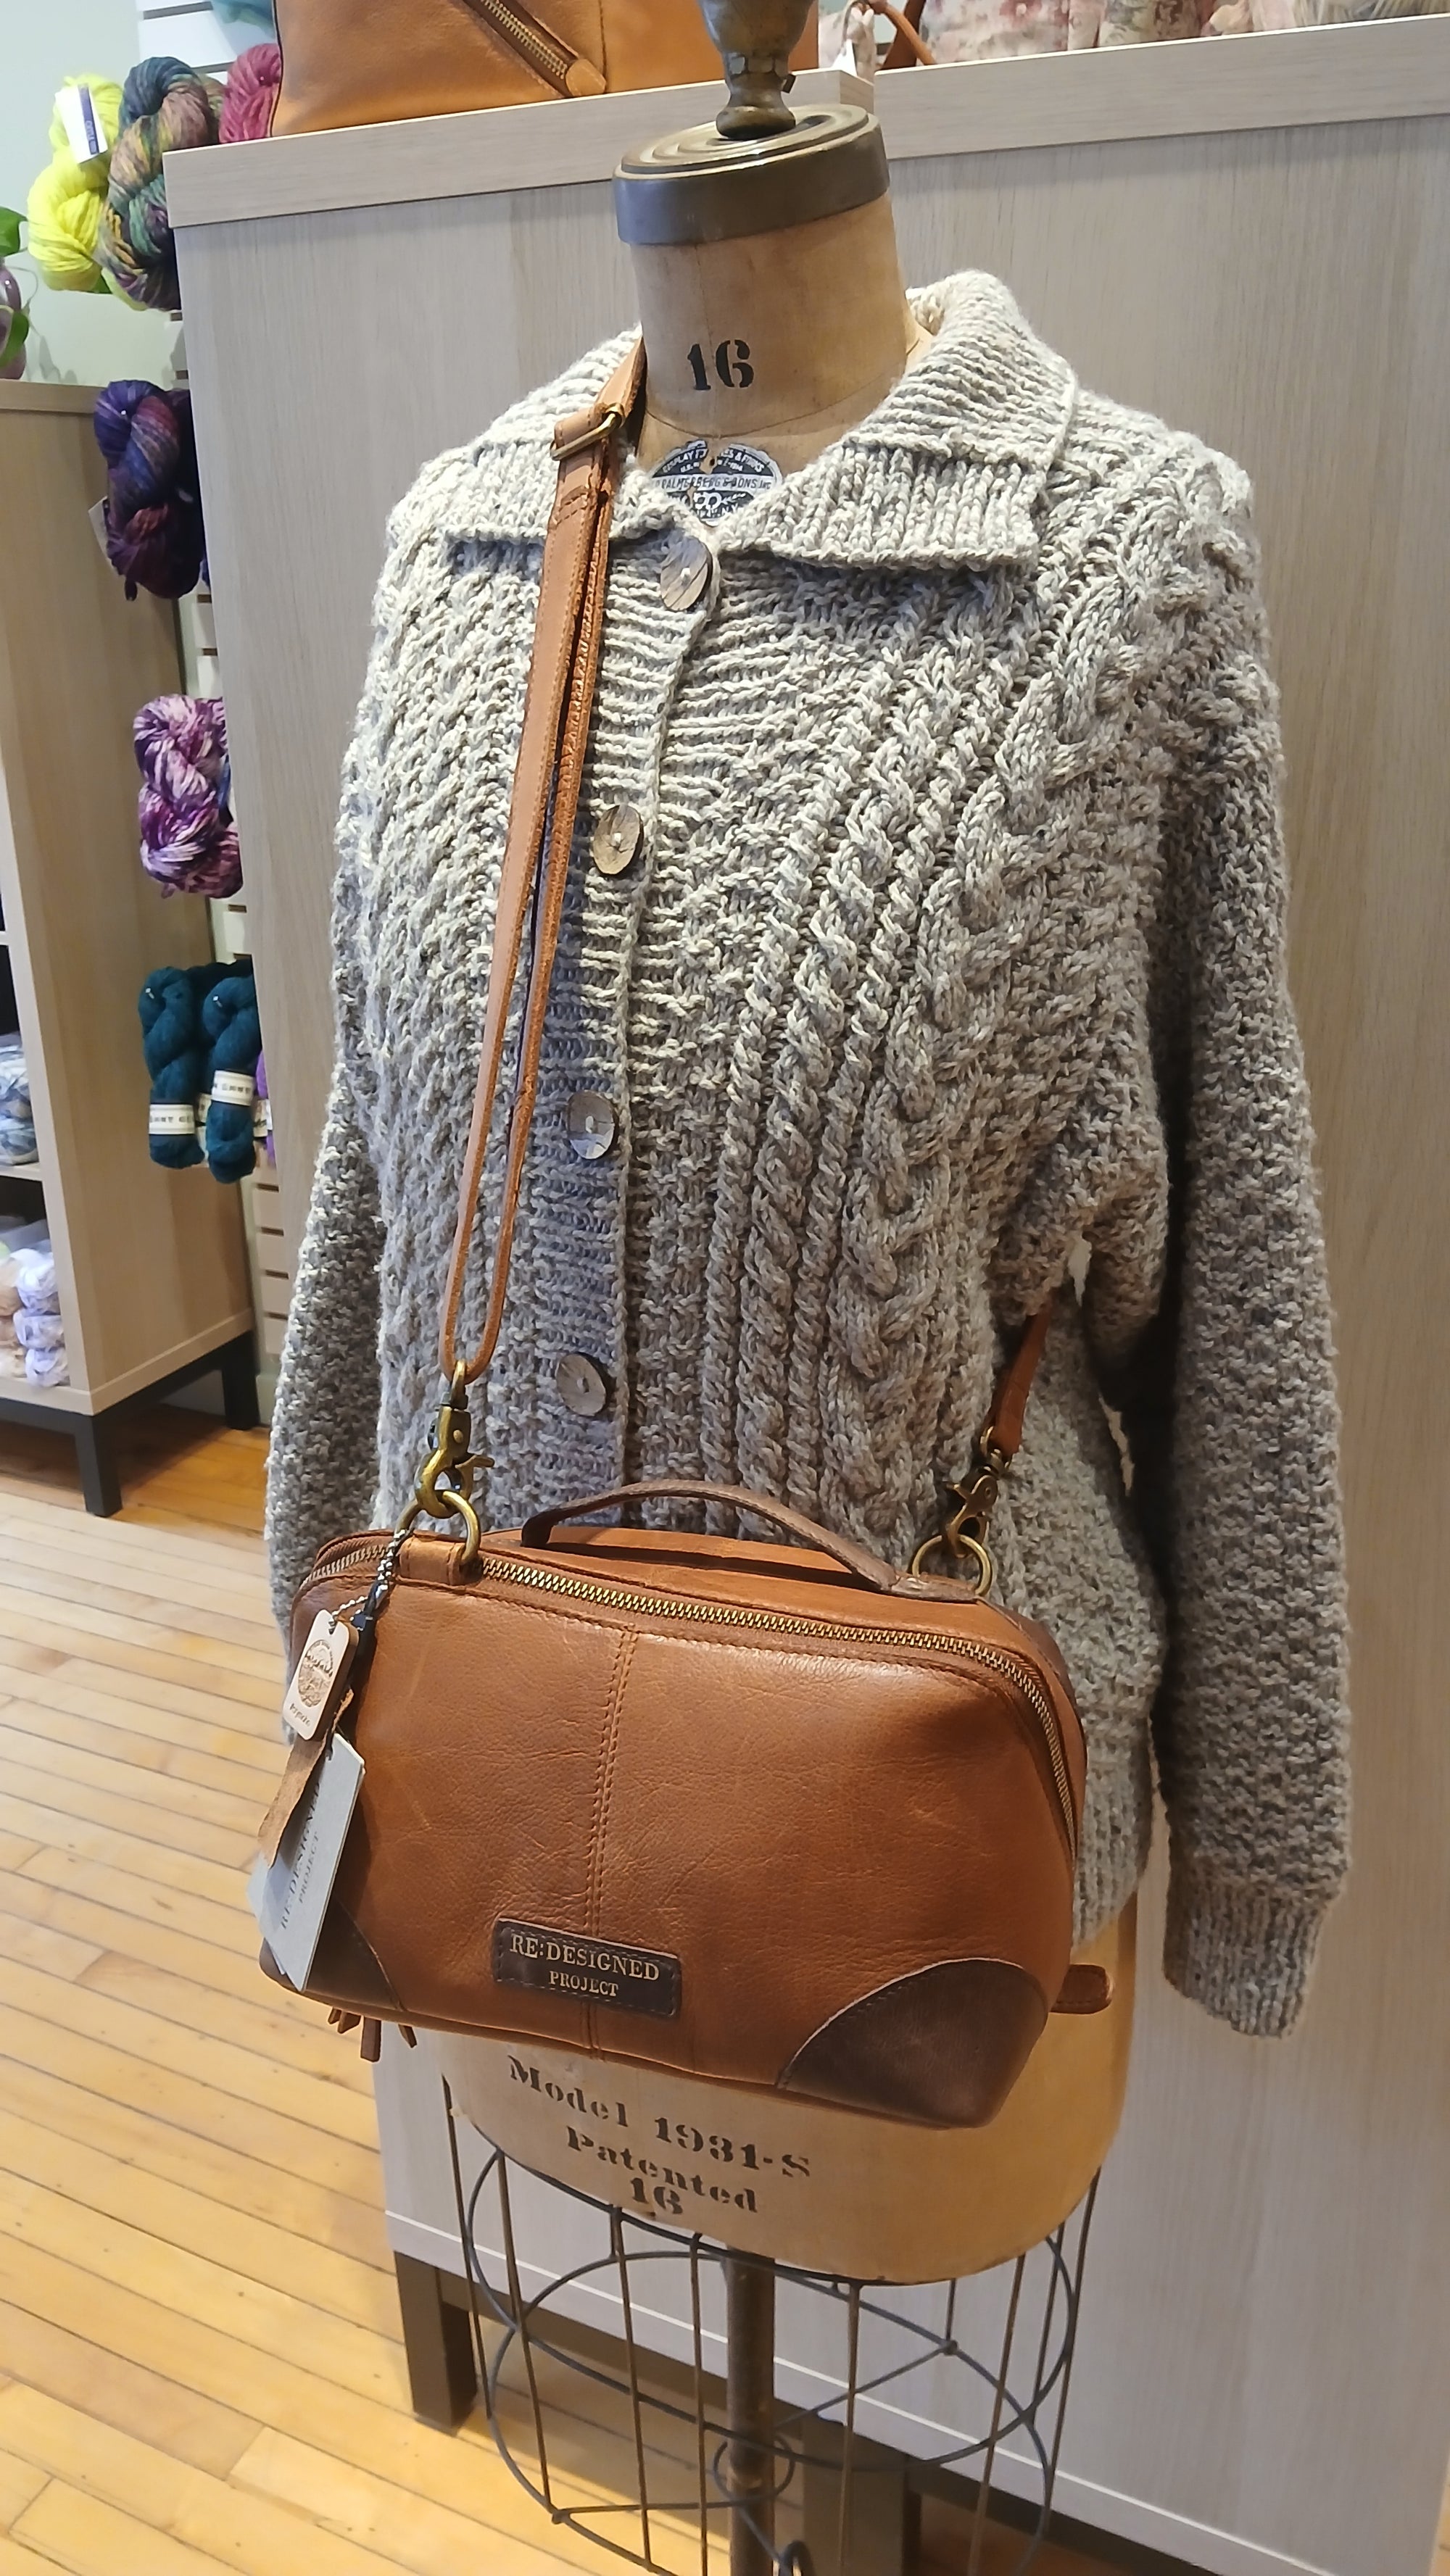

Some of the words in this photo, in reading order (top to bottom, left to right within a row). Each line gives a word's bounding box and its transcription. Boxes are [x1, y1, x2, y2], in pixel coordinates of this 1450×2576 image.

[687, 339, 754, 390] 16
[298, 1830, 320, 1905] PROJECT
[509, 1933, 660, 1981] RE:DESIGNED
[548, 1970, 618, 1997] PROJECT
[508, 2054, 629, 2127] Model
[654, 2116, 811, 2177] 1931-S
[566, 2125, 758, 2213] Patented
[629, 2177, 684, 2215] 16
